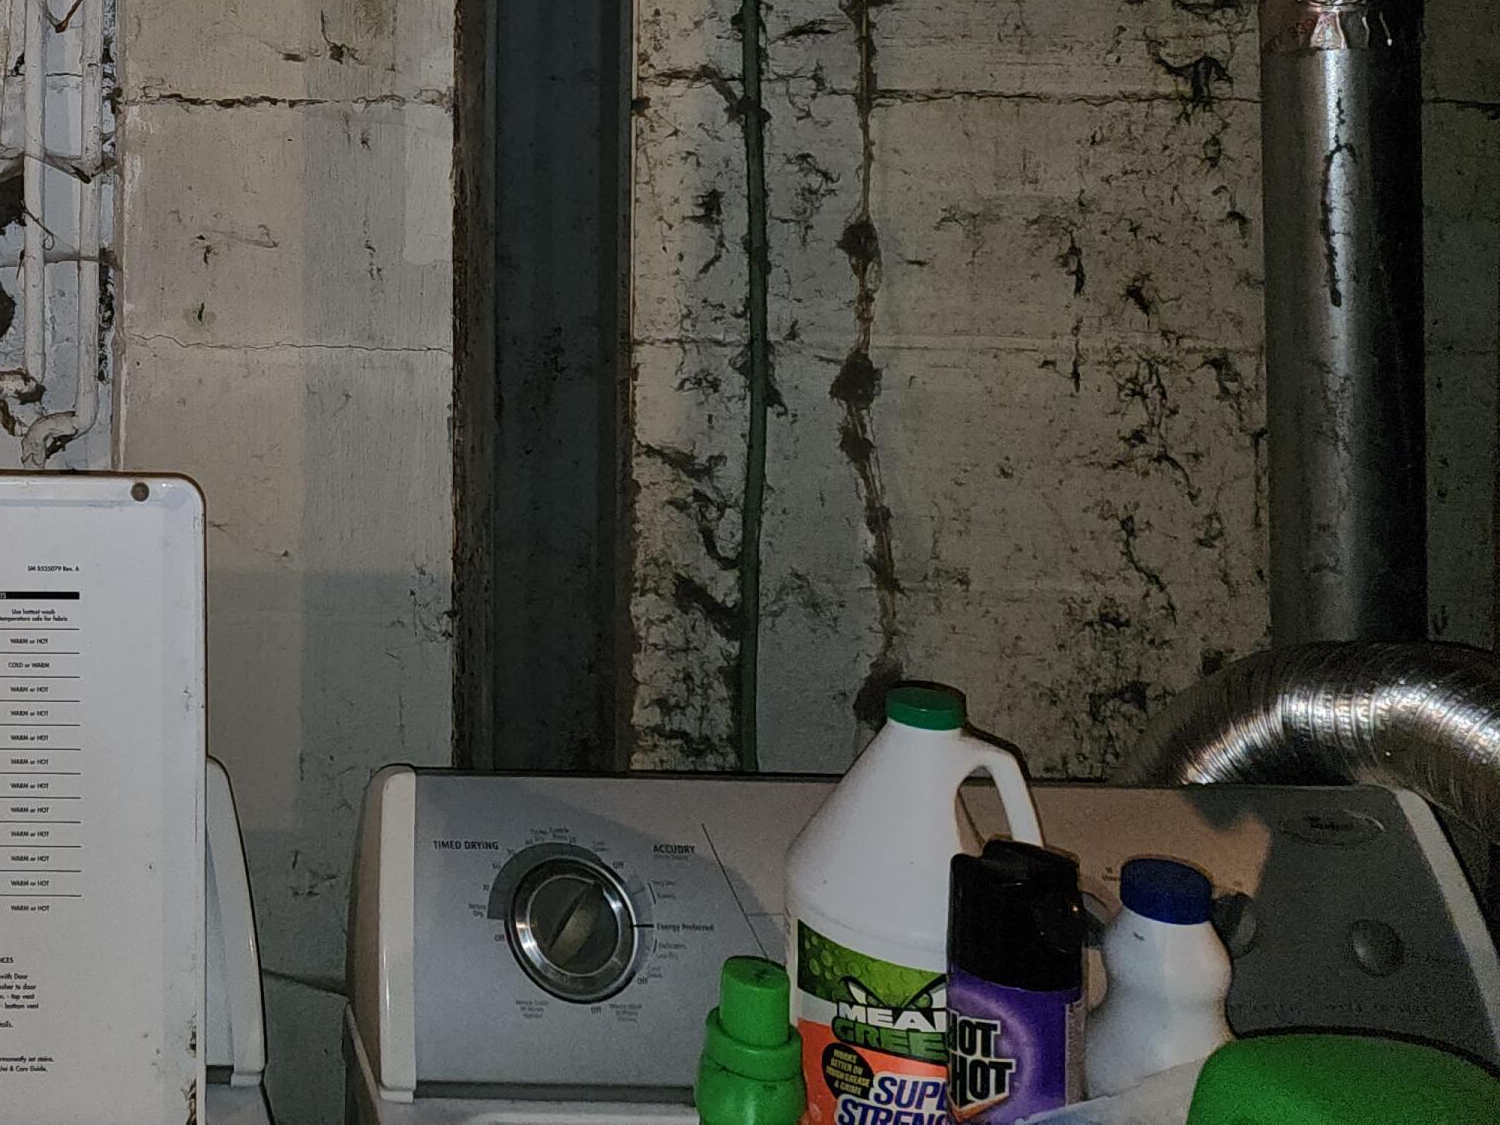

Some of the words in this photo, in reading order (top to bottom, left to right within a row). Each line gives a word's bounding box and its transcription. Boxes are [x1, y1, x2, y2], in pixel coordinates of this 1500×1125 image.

[433, 840, 462, 850] TIMED
[464, 841, 499, 850] DRYING
[653, 844, 695, 854] ACCUDRY
[656, 923, 680, 931] Energy
[833, 1016, 948, 1064] GREE
[950, 1054, 1013, 1107] HOT
[874, 1076, 947, 1111] SUP
